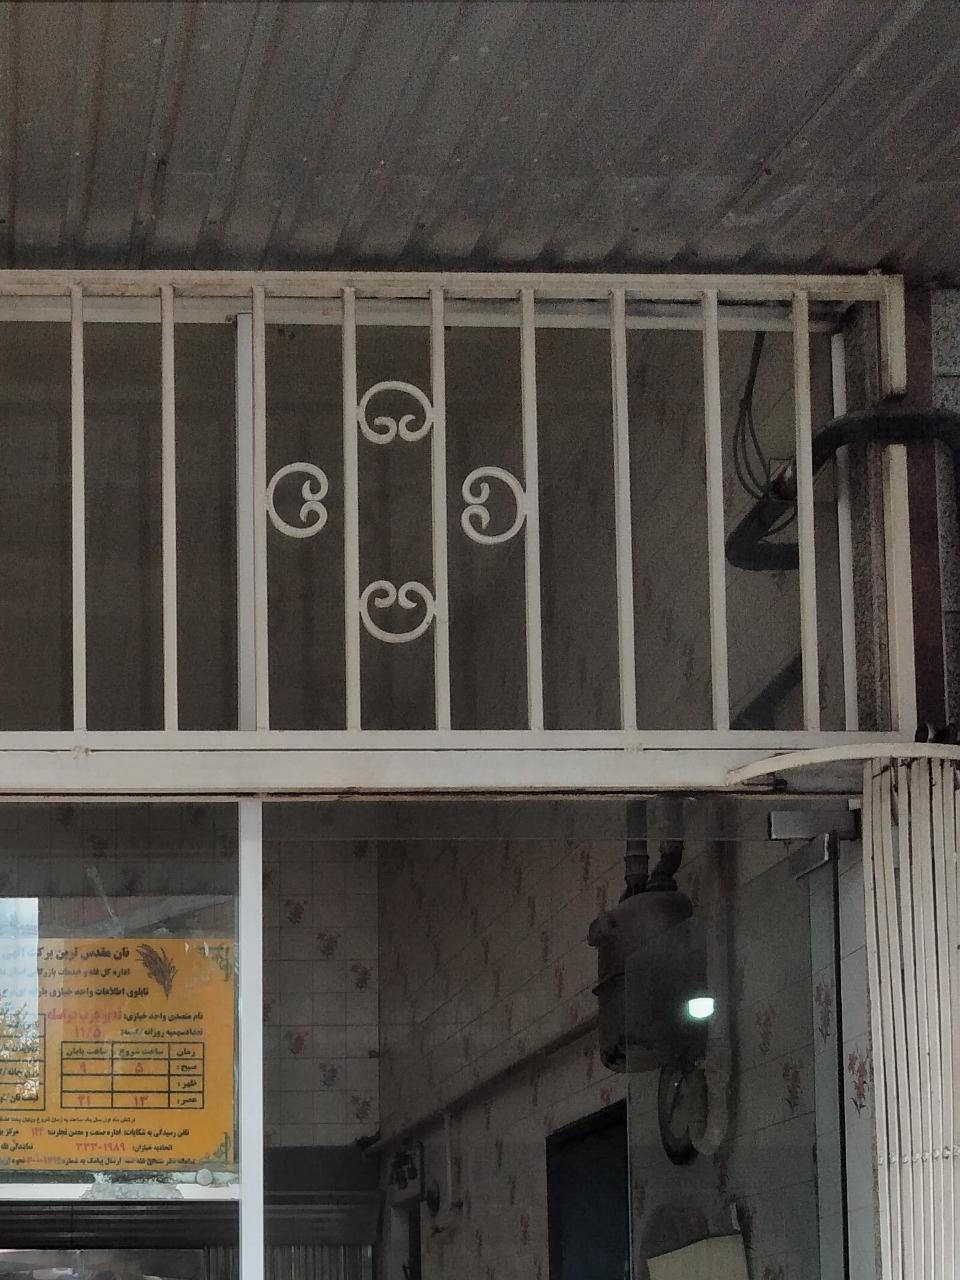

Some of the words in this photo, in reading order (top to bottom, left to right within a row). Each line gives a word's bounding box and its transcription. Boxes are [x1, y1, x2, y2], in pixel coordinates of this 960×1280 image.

[55, 945, 79, 961] ترین
[81, 946, 111, 960] مقدس
[113, 946, 130, 960] نان
[58, 967, 82, 977] خدمات
[88, 967, 100, 977] غله
[101, 967, 111, 978] کل
[113, 967, 130, 978] اداره
[49, 987, 73, 998] خبازی
[75, 987, 93, 998] واحد
[95, 986, 124, 997] اطلاعات
[127, 987, 149, 998] تابلوی
[149, 1012, 167, 1023] واحد
[168, 1013, 191, 1023] متصدی
[193, 1012, 203, 1022] نام
[144, 1027, 165, 1038] روزانه
[87, 1047, 108, 1056] ساعت
[145, 1047, 164, 1056] ساعت
[134, 1061, 144, 1073] ۵
[5, 1127, 19, 1137] مرکز
[68, 1127, 84, 1138] معدن
[89, 1127, 106, 1137] صنعت
[107, 1127, 122, 1138] اداره
[153, 1127, 176, 1138] رسیدگی
[177, 1127, 191, 1138] تلفن
[153, 1143, 173, 1153] اتحادیه
